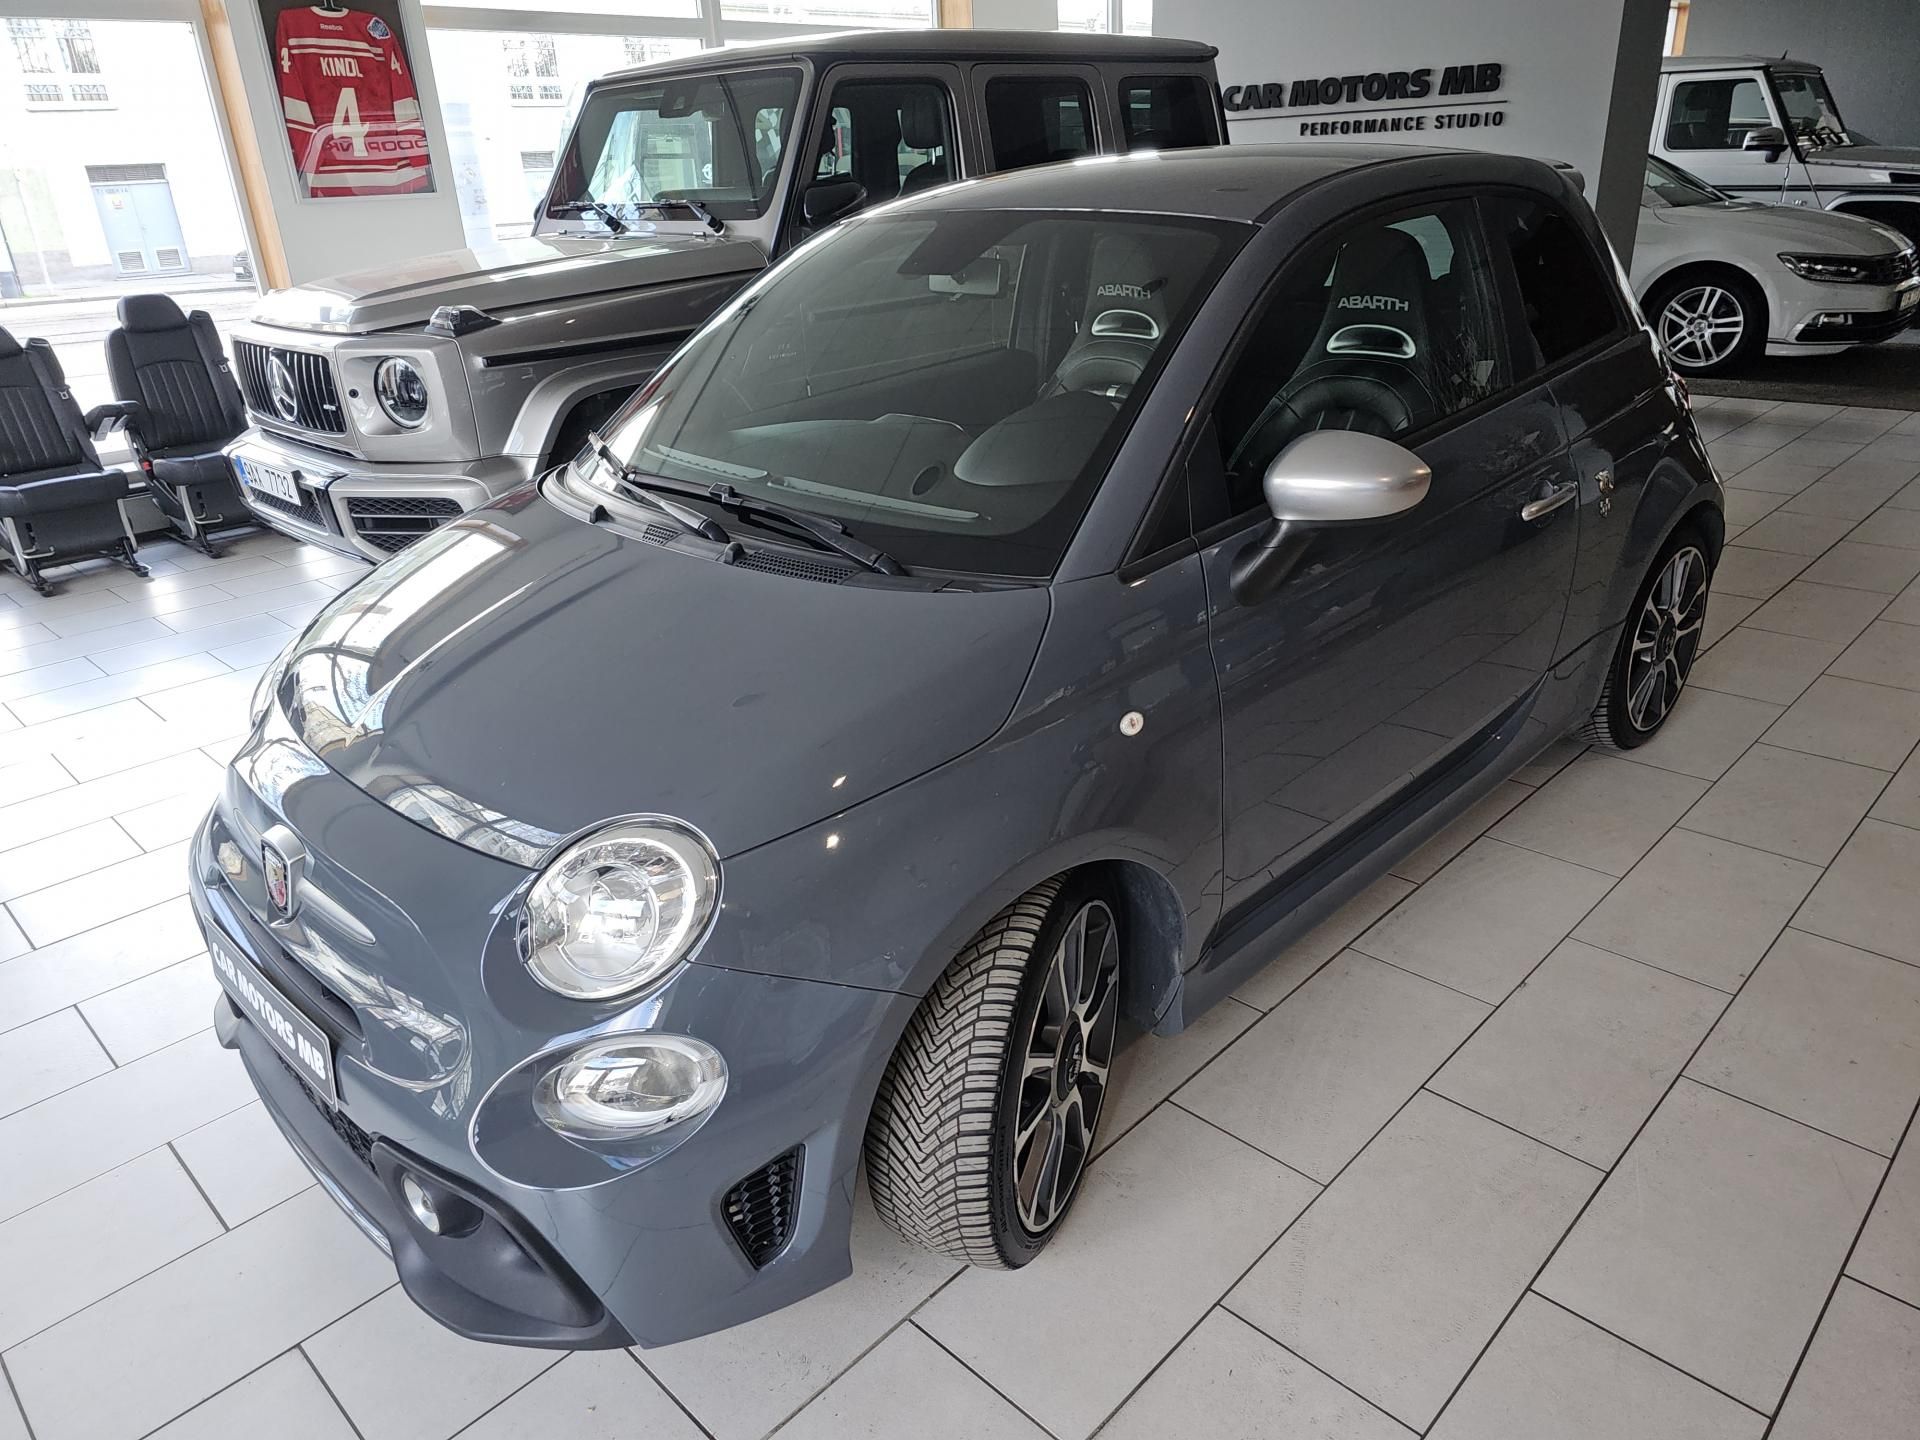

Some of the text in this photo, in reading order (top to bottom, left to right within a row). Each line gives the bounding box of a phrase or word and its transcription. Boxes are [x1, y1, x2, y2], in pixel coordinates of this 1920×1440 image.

[280, 47, 291, 73] 4
[320, 57, 363, 78] KINDL
[390, 51, 402, 75] 4
[1222, 62, 1503, 112] CAR MOTORS MB
[333, 87, 370, 157] 4
[1300, 111, 1504, 137] PERFORMANCE STUDIO
[1097, 283, 1151, 299] ABARTH
[1337, 295, 1409, 312] ABARTH
[212, 942, 326, 1080] CAR MOTORS MB
